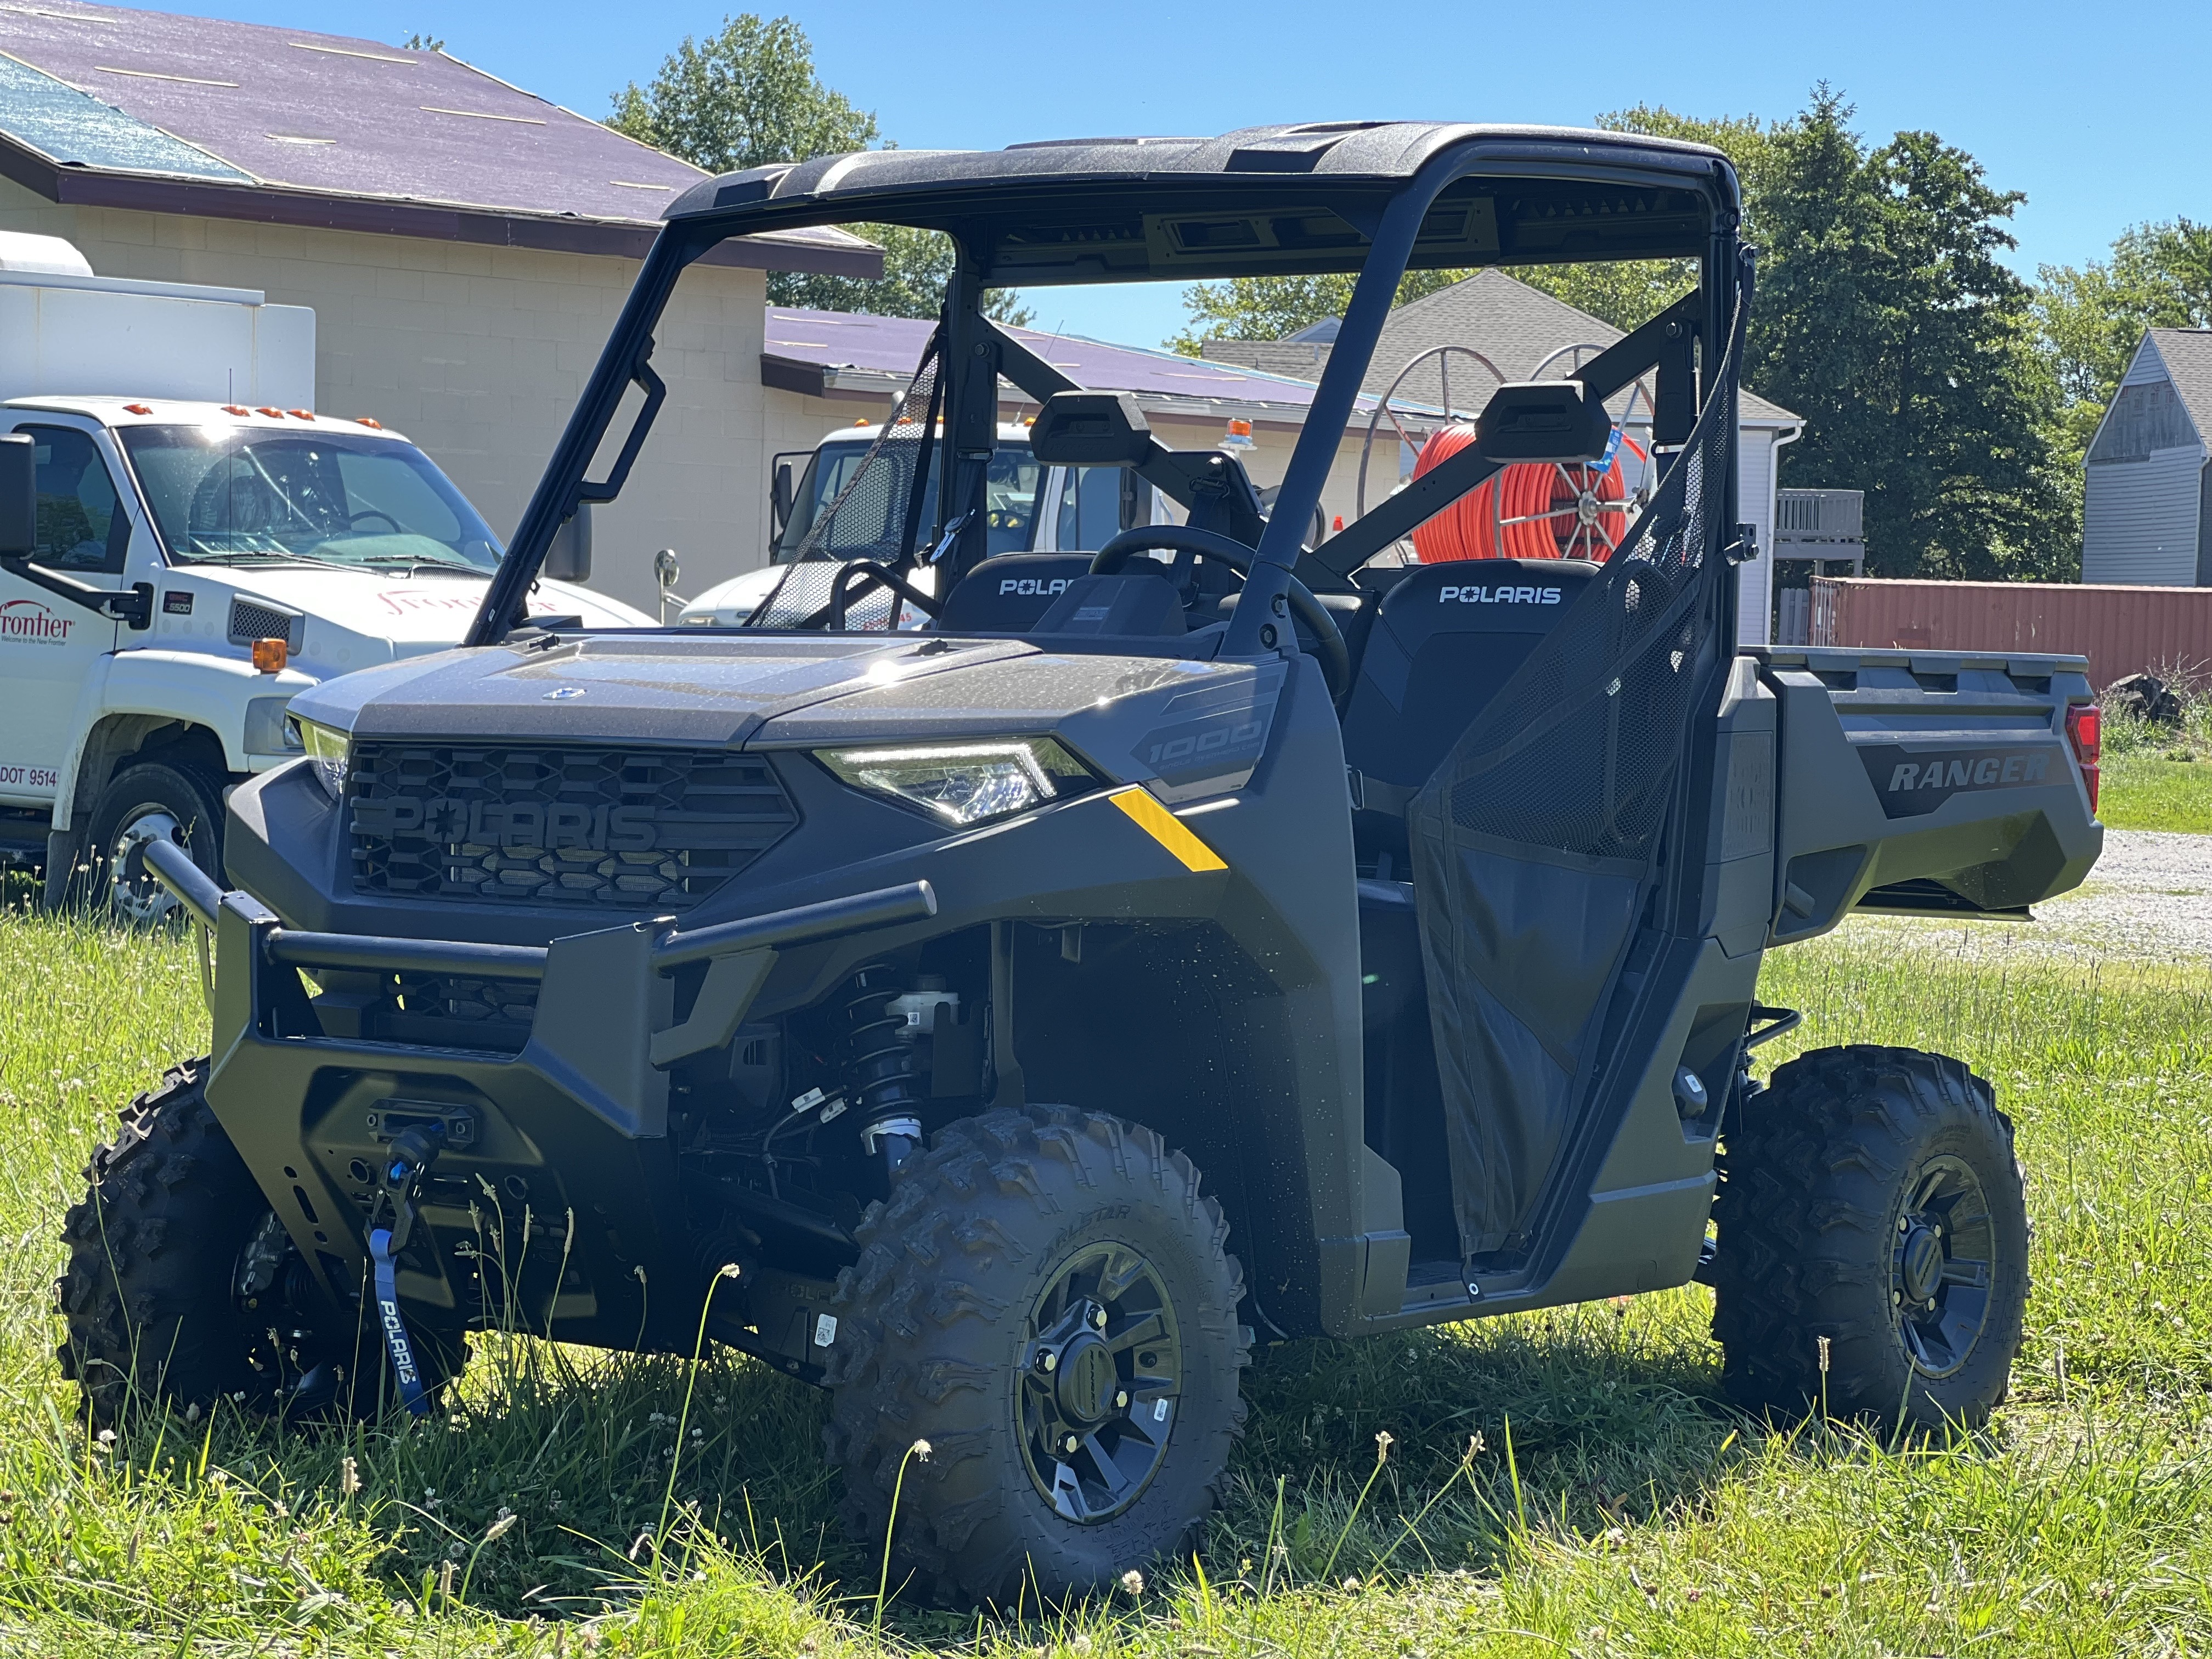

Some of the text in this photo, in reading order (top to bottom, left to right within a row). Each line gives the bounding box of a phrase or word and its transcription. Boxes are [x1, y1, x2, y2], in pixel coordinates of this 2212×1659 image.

[998, 579, 1074, 595] POLA
[1439, 586, 1561, 604] POLARIS
[48, 638, 66, 646] Frontier
[1149, 720, 1262, 764] 1000
[0, 766, 60, 787] DOT 9514
[1888, 754, 2050, 792] RANGER
[385, 795, 656, 851] POLARIS
[380, 1300, 416, 1385] POLARIS
